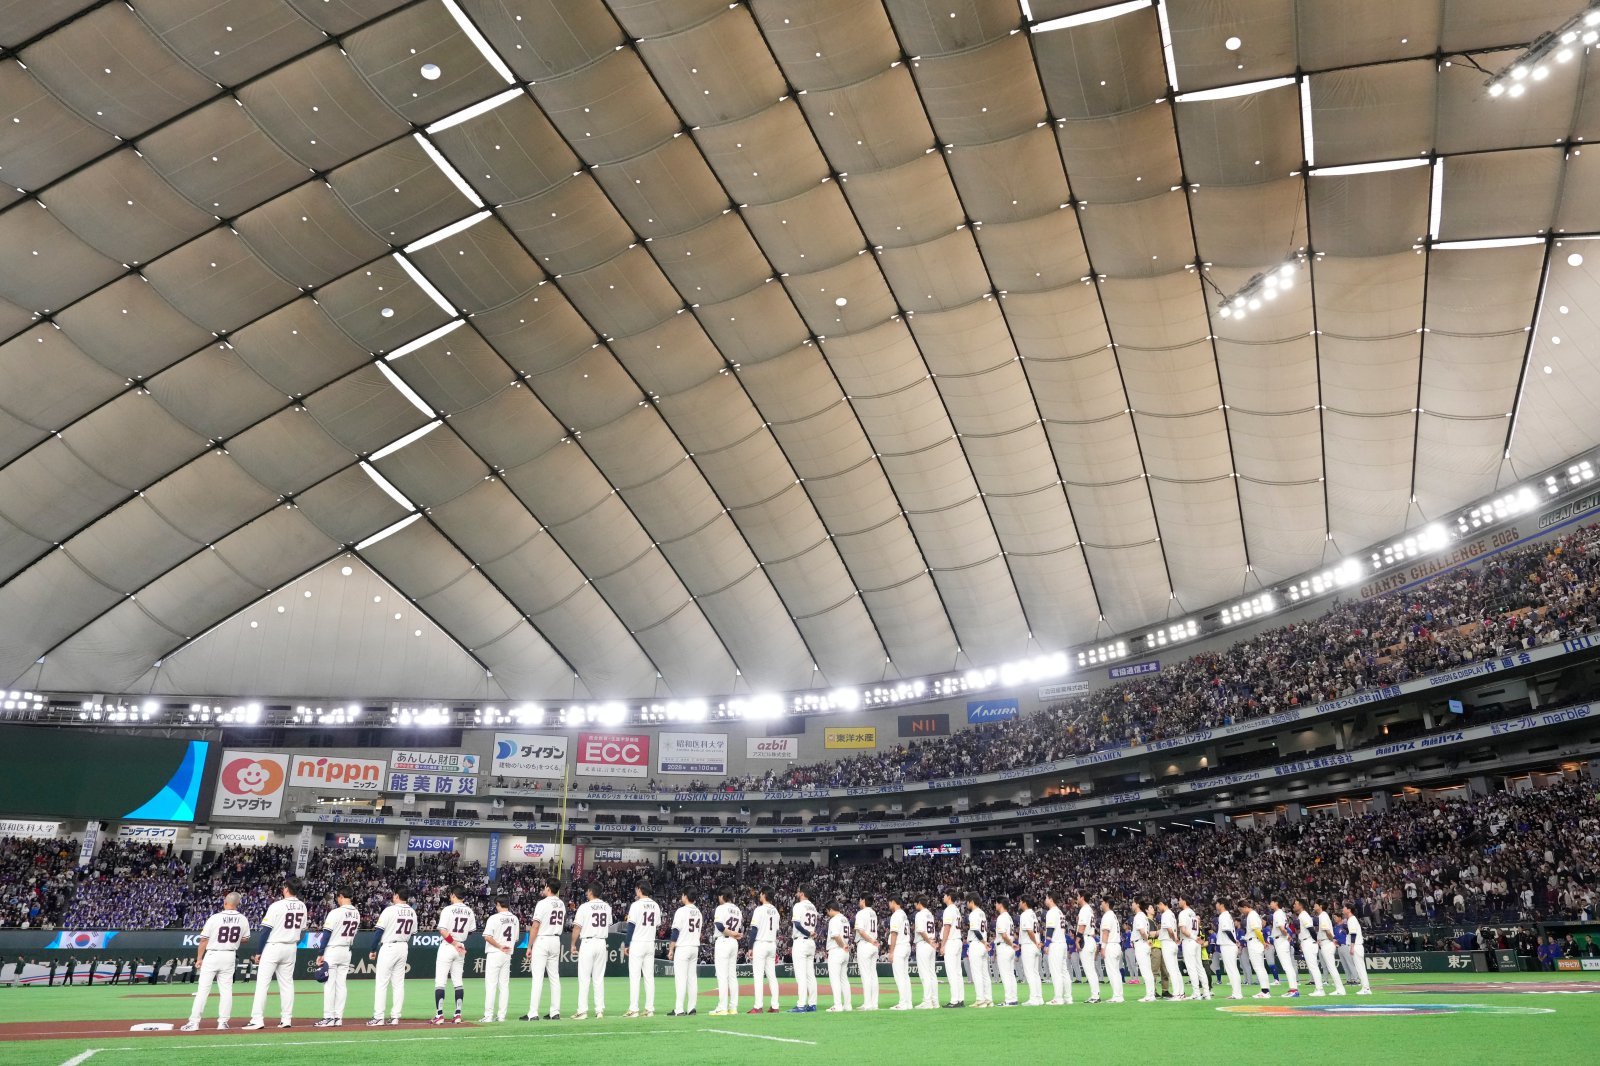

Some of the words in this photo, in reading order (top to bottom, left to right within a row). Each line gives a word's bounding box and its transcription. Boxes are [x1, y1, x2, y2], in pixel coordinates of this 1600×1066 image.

[1539, 503, 1572, 528] GREAT
[1361, 573, 1406, 598] GIANTS
[1410, 541, 1487, 579] CHALLENGE
[1491, 527, 1519, 548] 2026
[1562, 636, 1592, 653] IHI
[1112, 662, 1157, 677] 電協通信工業
[1485, 652, 1532, 673] 作画会
[1430, 675, 1453, 686] DESIGN
[1458, 666, 1484, 679] DISPLAY
[1316, 694, 1371, 713] 100年をつくる会社
[1383, 685, 1402, 700] 鹿島
[1543, 708, 1585, 724] marble
[1500, 717, 1536, 732] マーブル
[676, 740, 724, 749] 昭和医科大学
[757, 740, 788, 751] azbil
[836, 733, 874, 743] 東洋水産
[397, 753, 459, 766] あんしん財団
[521, 745, 564, 759] ダイダン
[586, 742, 640, 763] ECC
[297, 758, 380, 783] nippn
[1274, 754, 1354, 775] 電協通信工業株式会社
[353, 781, 377, 789] ニップン
[391, 774, 474, 795] 能美防災
[675, 793, 708, 801] DUSKIN
[712, 792, 745, 801] DUSKIN
[222, 798, 272, 811] シマダヤ
[121, 826, 176, 837] ニッテイライフ
[215, 833, 256, 841] YOKOGAWA
[409, 839, 450, 849] SAISON
[679, 851, 720, 862] TOTO
[284, 912, 304, 929] 85
[452, 917, 468, 933] 17
[550, 910, 563, 925] 29
[592, 912, 607, 927] 38
[642, 911, 655, 926] 14
[726, 917, 739, 931] 47
[769, 917, 773, 930] 1
[804, 913, 817, 927] 33
[341, 921, 358, 937] 72
[396, 918, 413, 935] 70
[689, 918, 700, 933] 54
[218, 926, 241, 943] 88
[503, 926, 512, 942] 4
[1448, 956, 1471, 969] 東テ
